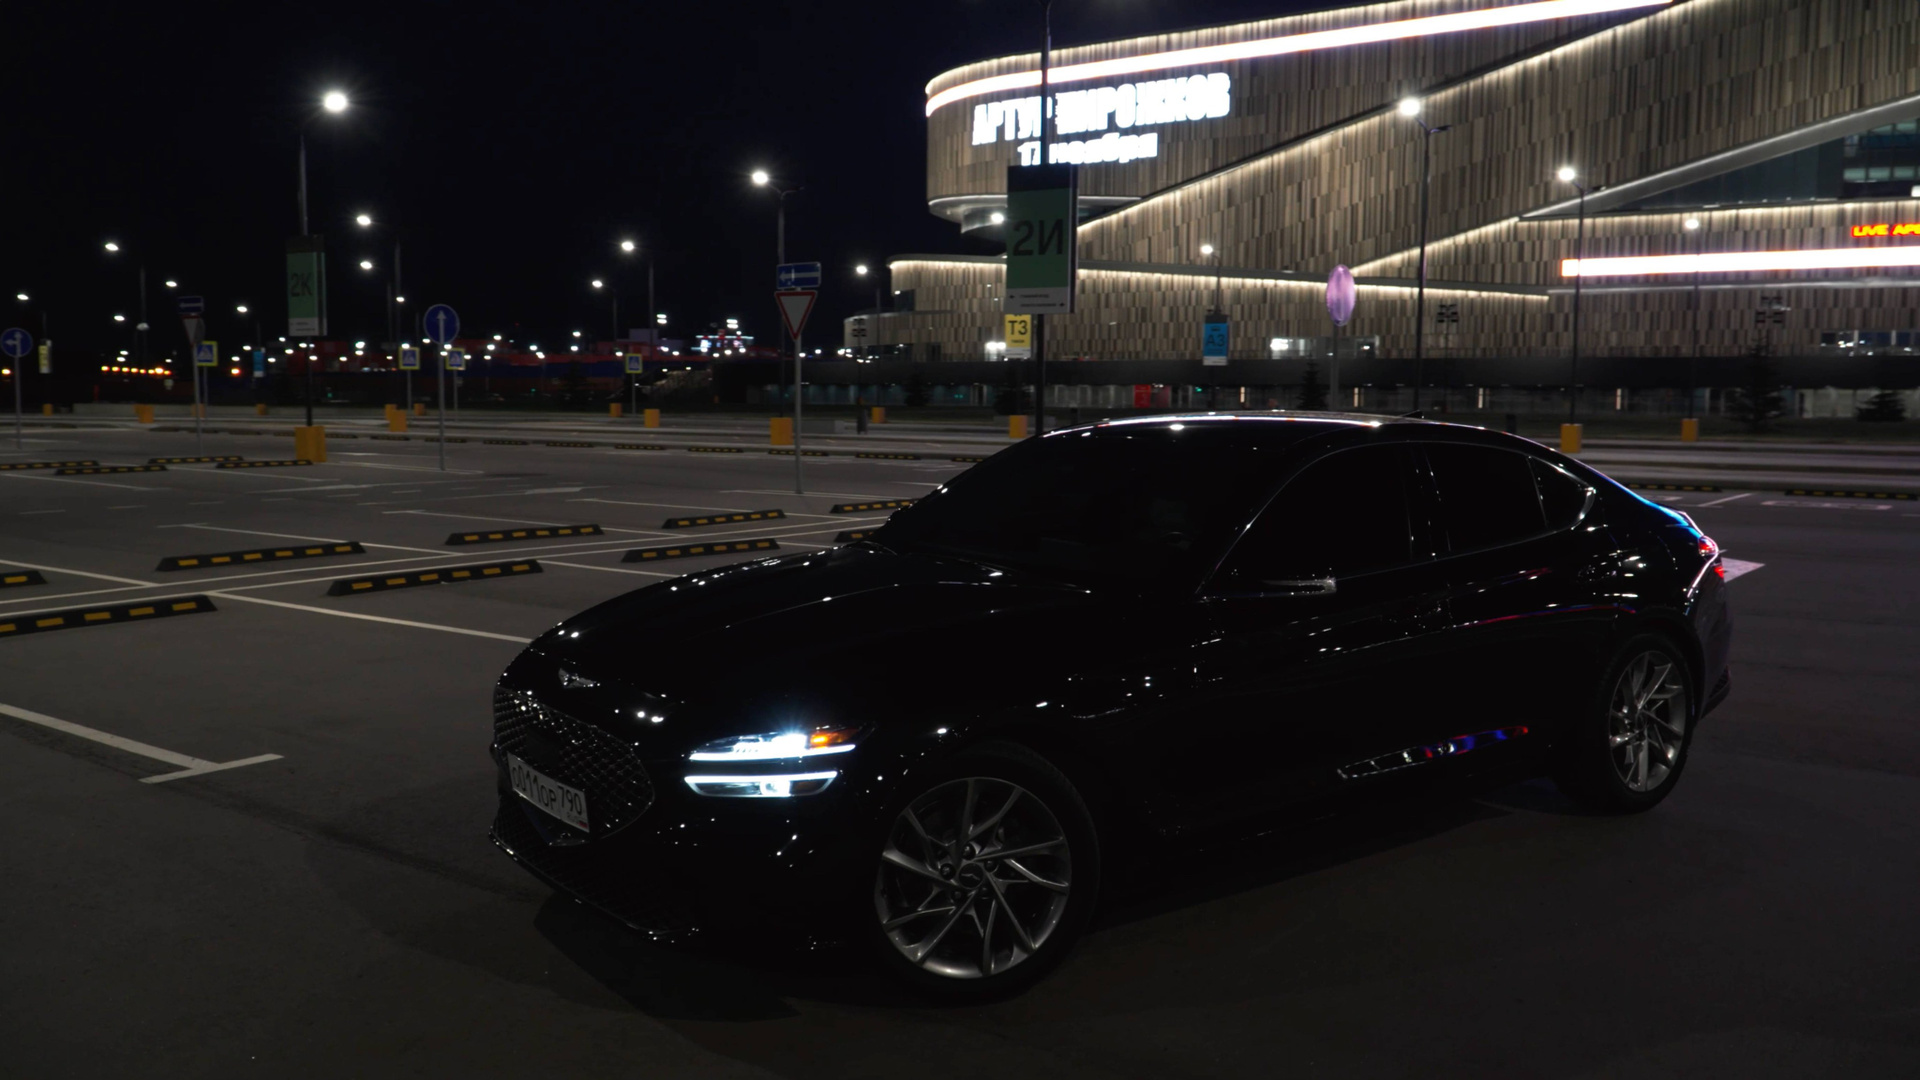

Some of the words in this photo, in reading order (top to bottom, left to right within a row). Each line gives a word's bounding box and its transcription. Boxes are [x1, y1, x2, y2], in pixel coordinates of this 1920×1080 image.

[1851, 224, 1889, 238] LIVE
[290, 272, 312, 297] 2К
[1008, 320, 1028, 335] Т3
[1206, 334, 1225, 347] А3
[557, 785, 583, 816] 790
